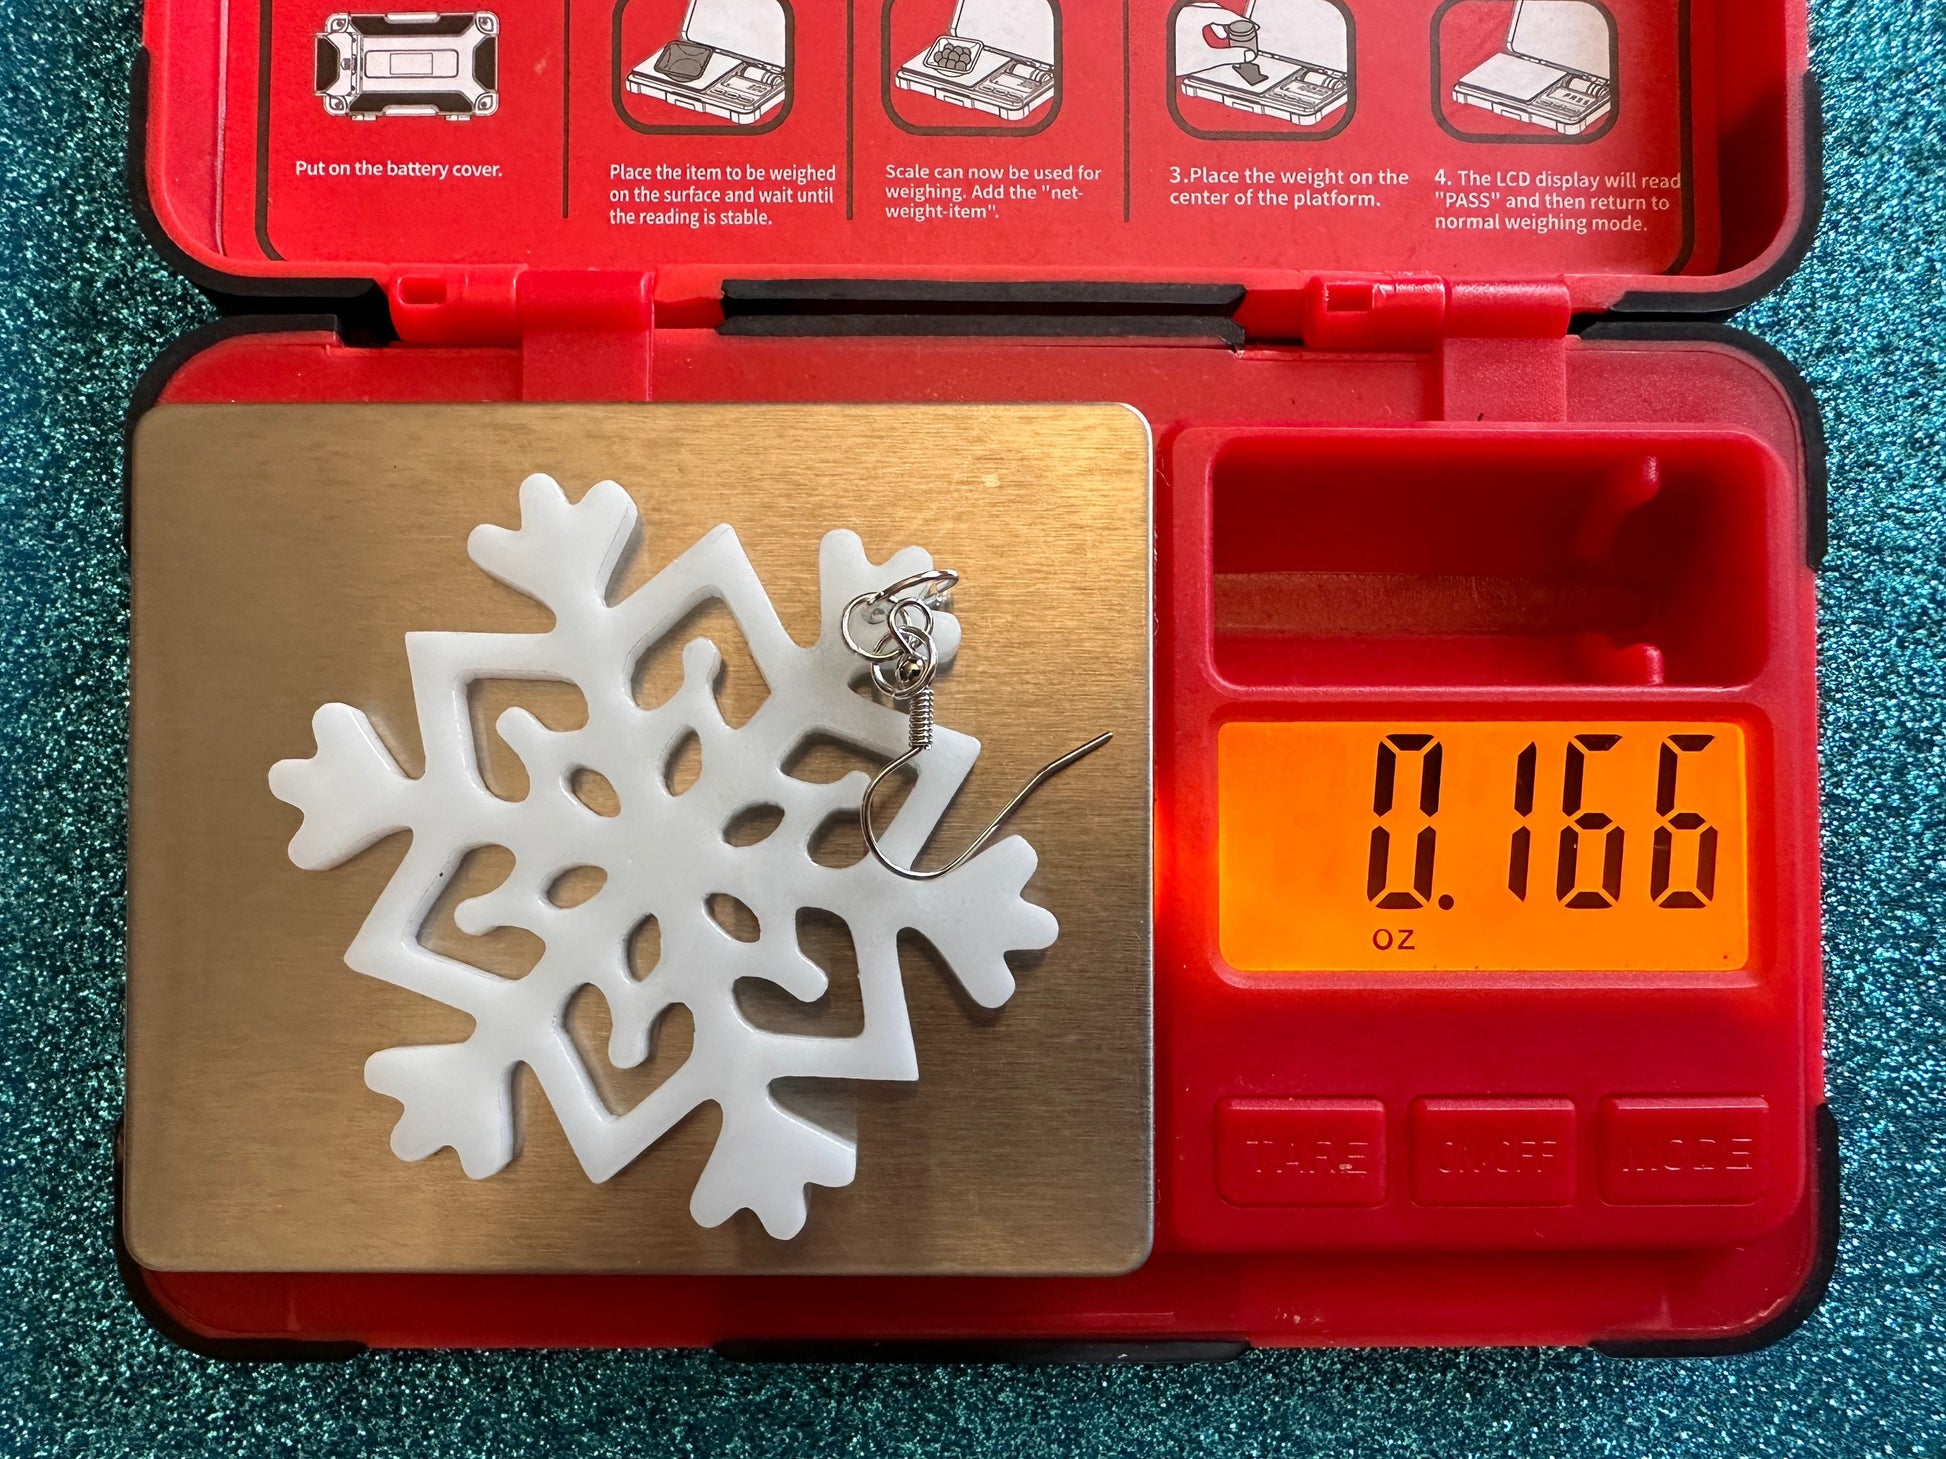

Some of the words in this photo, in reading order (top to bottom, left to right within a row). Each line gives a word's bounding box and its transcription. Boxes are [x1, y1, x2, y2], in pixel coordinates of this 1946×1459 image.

[296, 160, 327, 176] Put
[328, 164, 351, 176] on
[354, 160, 384, 176] the
[387, 160, 450, 180] battery
[452, 164, 502, 177] cover.
[610, 163, 652, 180] Place
[656, 163, 682, 180] the
[686, 163, 721, 180] item
[726, 166, 742, 180] to
[746, 164, 765, 181] be
[770, 164, 836, 185] weighed
[886, 164, 929, 178] Scale
[934, 168, 963, 179] can
[969, 168, 1004, 179] now
[1009, 165, 1029, 179] be
[1034, 165, 1073, 180] used
[1078, 165, 1102, 181] for
[1244, 167, 1275, 183] the
[1281, 168, 1344, 188] weight
[1350, 173, 1374, 186] on
[1378, 168, 1409, 184] the
[1434, 169, 1452, 185] 4.
[1457, 170, 1491, 186] The
[1497, 171, 1530, 186] LCD
[1536, 171, 1600, 191] display
[1605, 172, 1636, 188] will
[1642, 172, 1681, 188] read
[610, 190, 629, 202] on
[634, 186, 660, 202] the
[664, 185, 720, 203] surface
[725, 186, 754, 202] and
[759, 186, 793, 203] wait
[798, 187, 833, 203] until
[885, 183, 966, 202] weighing.
[972, 184, 1004, 199] Add
[1009, 184, 1037, 199] the
[1170, 190, 1229, 205] center
[1234, 189, 1253, 205] of
[1258, 189, 1288, 206] the
[1294, 189, 1380, 210] platform.
[1435, 191, 1500, 208] "PASS"
[1506, 192, 1539, 208] and
[1545, 192, 1585, 209] then
[1591, 195, 1646, 210] return
[1651, 196, 1670, 210] to
[609, 208, 636, 224] the
[639, 208, 700, 229] reading
[704, 208, 716, 225] is
[720, 208, 772, 226] stable.
[1436, 213, 1500, 229] normal
[1505, 213, 1587, 235] weighing
[1592, 215, 1647, 231] mode.
[1367, 733, 1718, 911] 0.166
[1246, 1140, 1369, 1175] TARE
[1619, 1137, 1754, 1173] MODE
